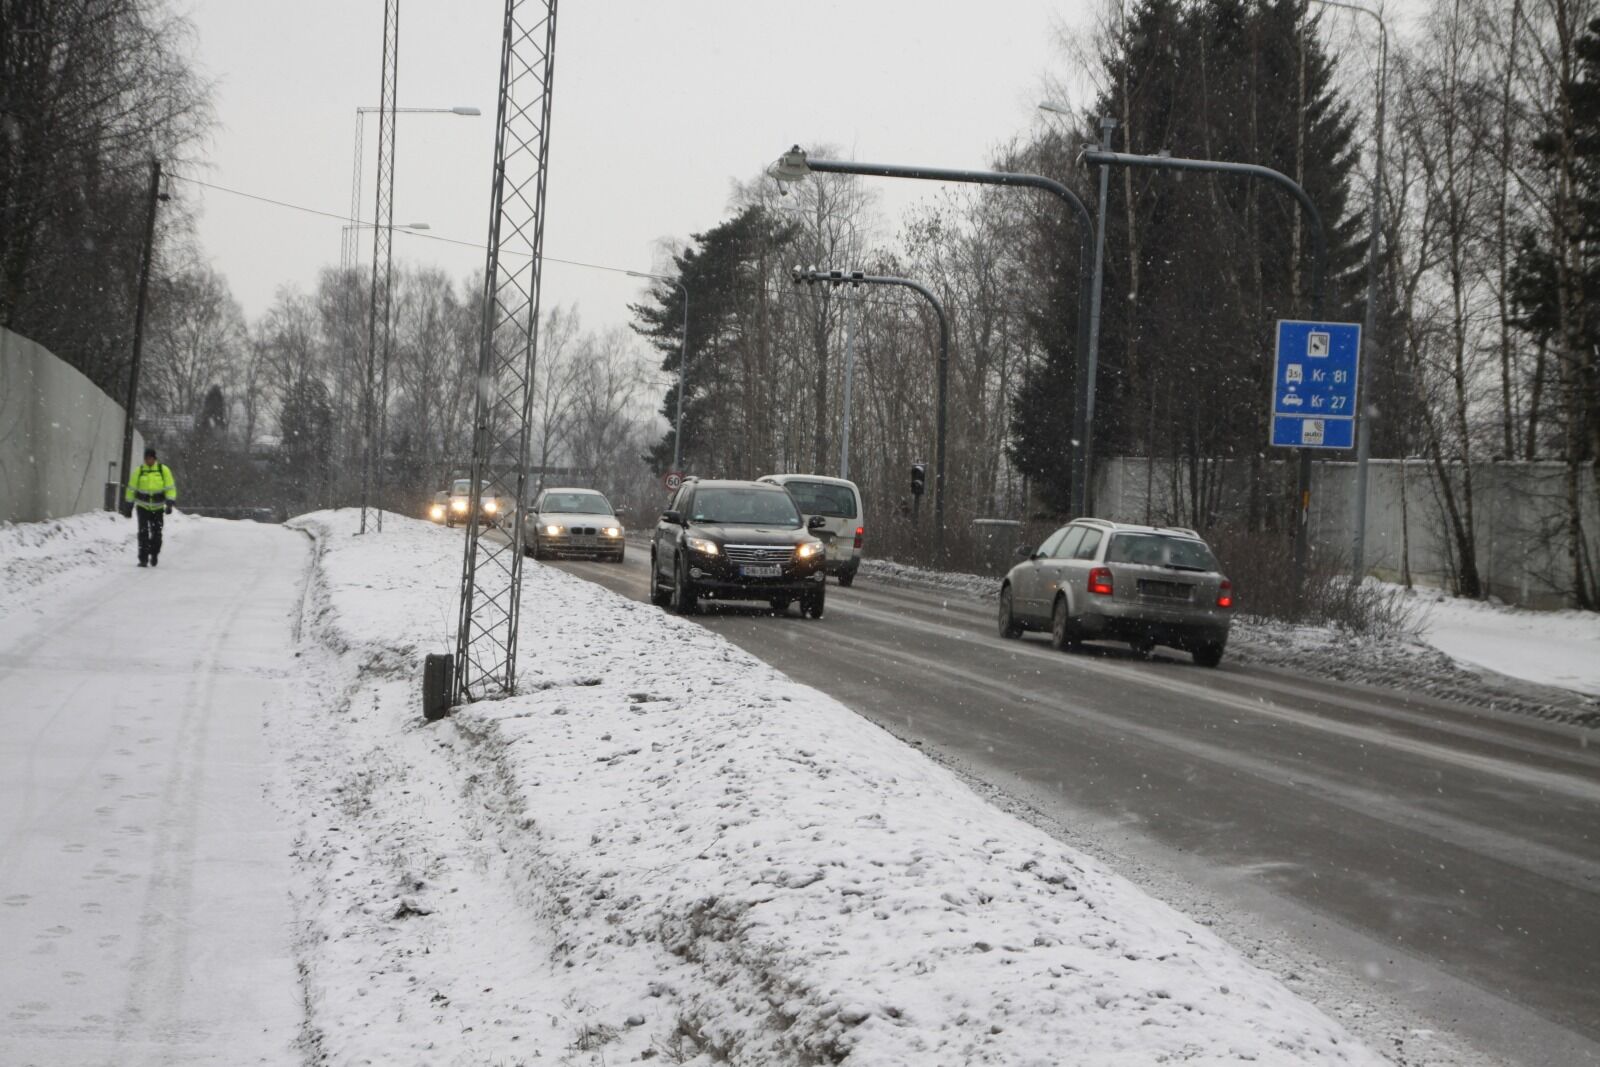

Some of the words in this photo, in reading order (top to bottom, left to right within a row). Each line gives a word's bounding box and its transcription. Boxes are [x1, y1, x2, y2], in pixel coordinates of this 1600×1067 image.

[1312, 369, 1326, 382] Kr
[1334, 370, 1347, 383] 81
[1311, 395, 1325, 408] Kr
[1331, 396, 1346, 409] 27
[668, 477, 680, 486] 60
